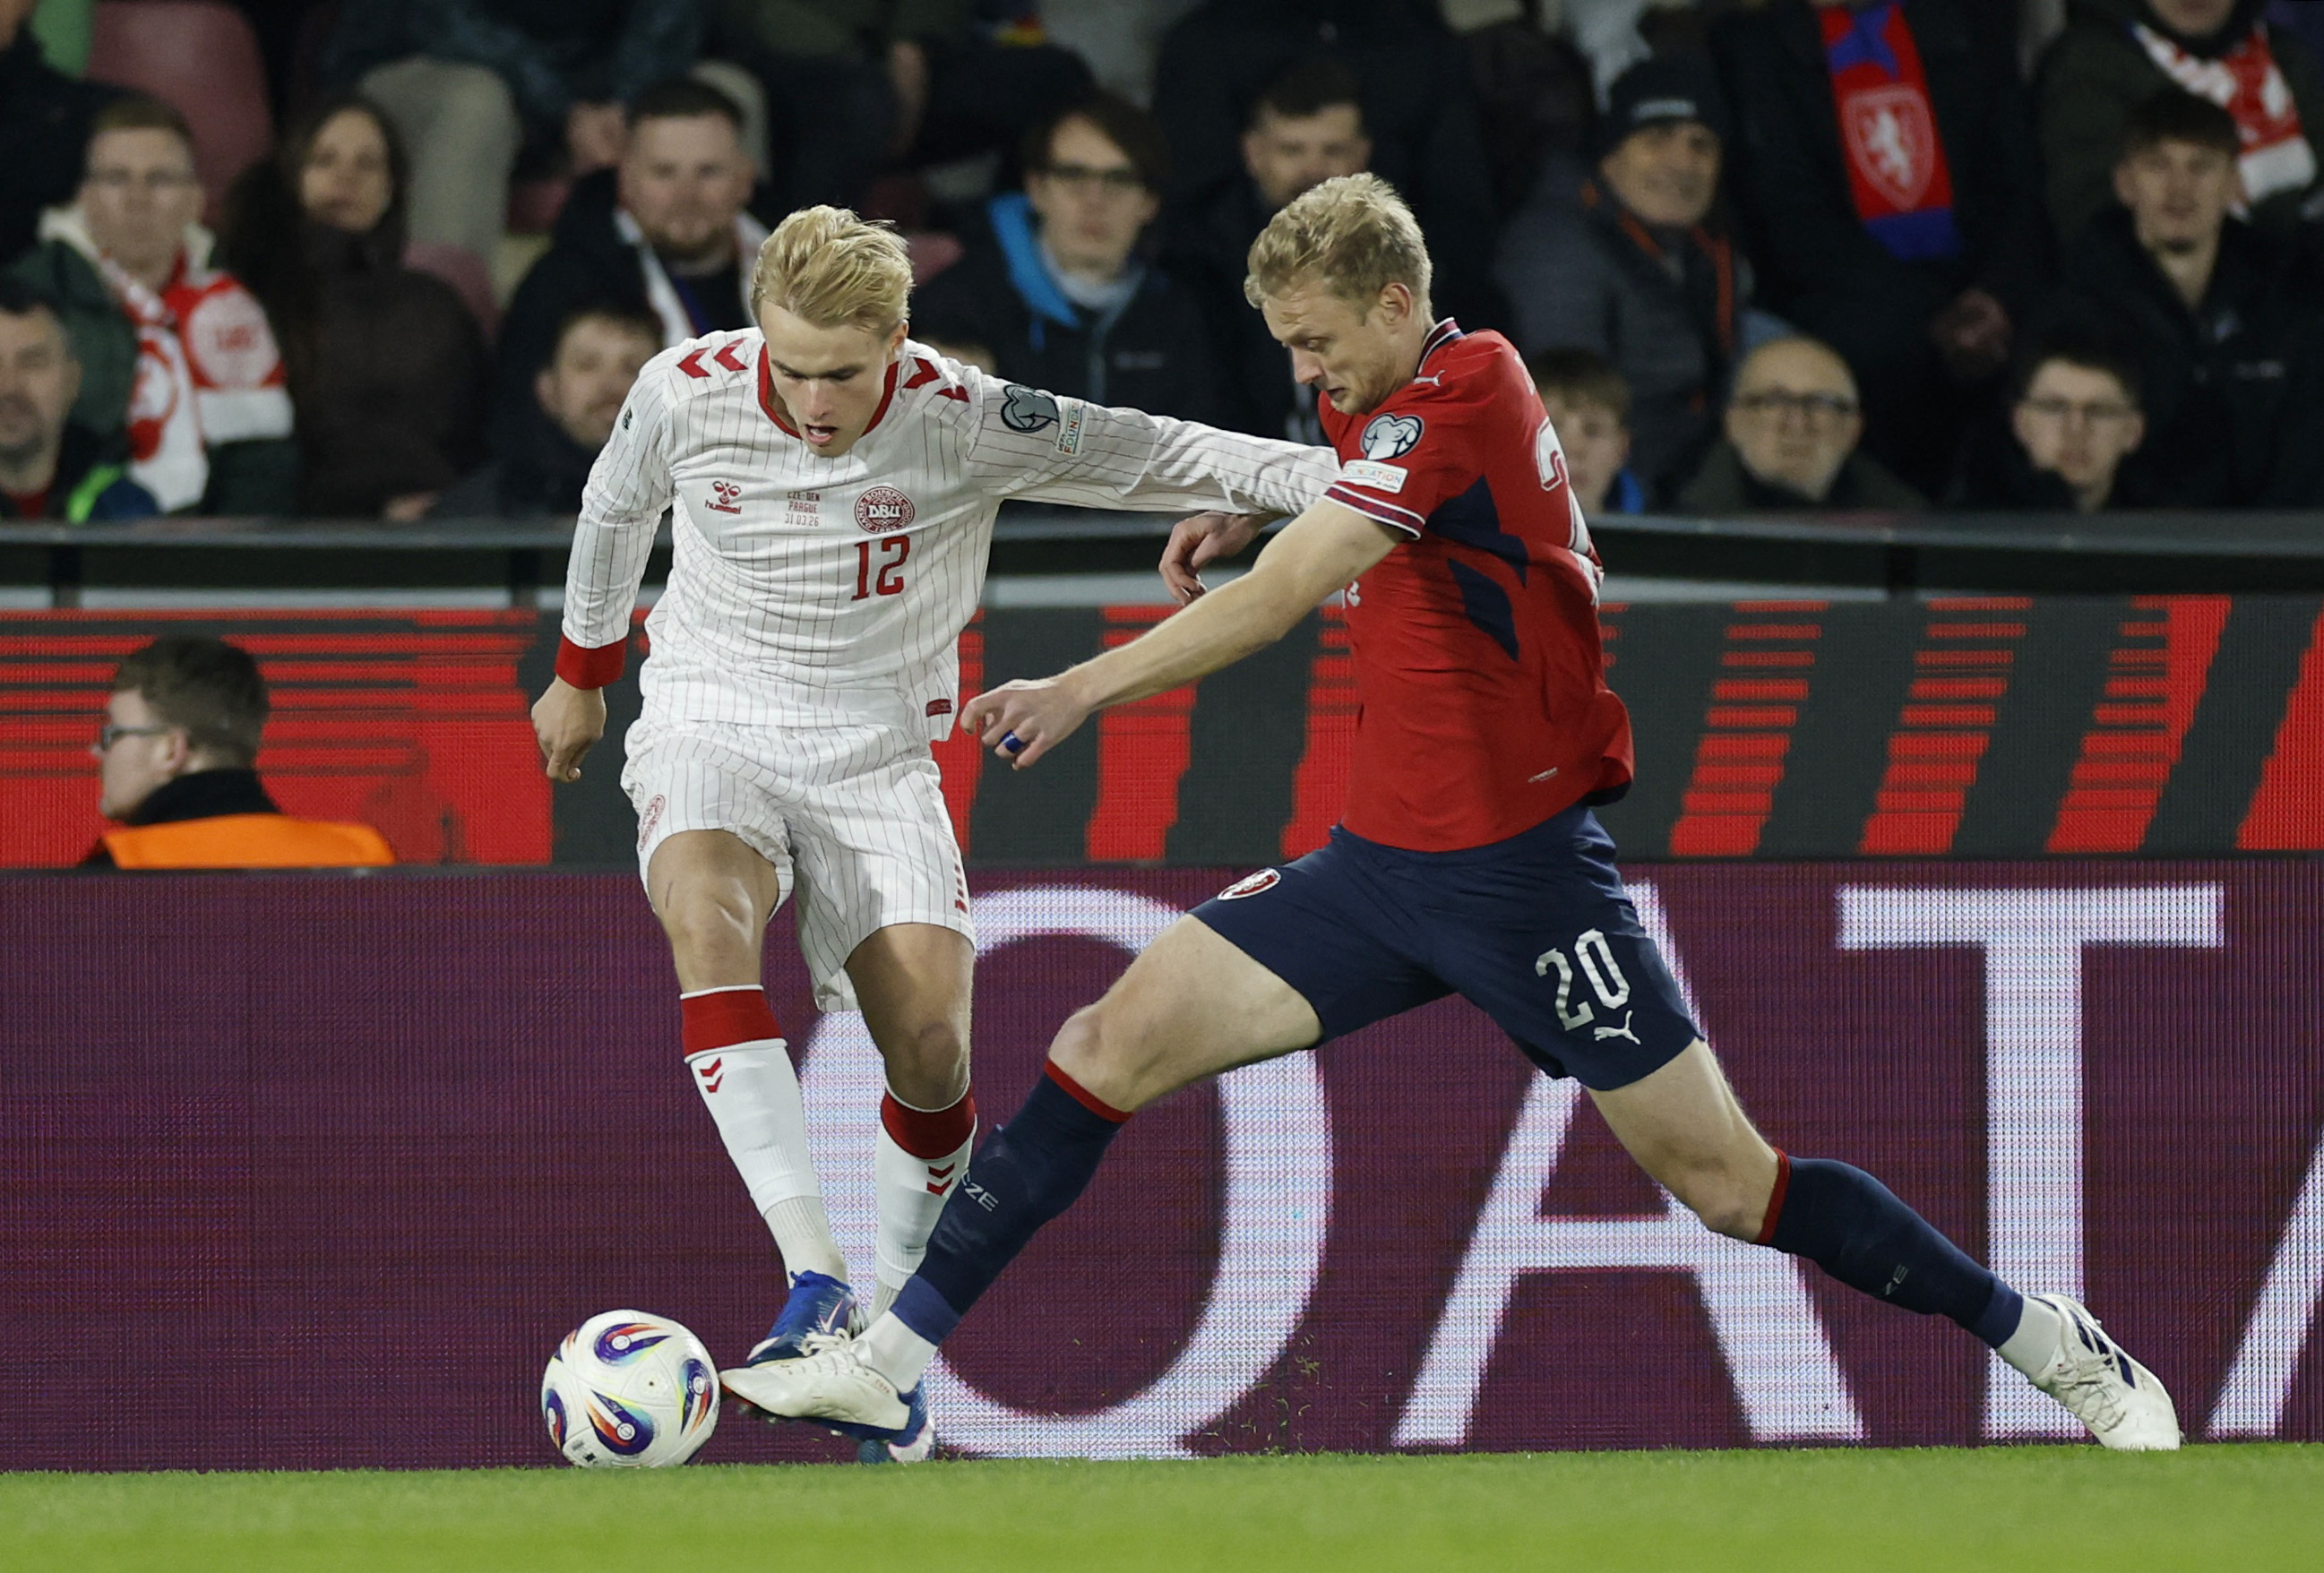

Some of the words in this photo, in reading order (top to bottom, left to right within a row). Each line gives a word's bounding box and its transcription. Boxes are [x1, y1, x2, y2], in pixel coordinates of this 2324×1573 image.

[704, 499, 742, 515] hummel
[788, 501, 818, 514] PRAGUE
[868, 504, 901, 518] DBU
[851, 535, 910, 601] 12
[1535, 927, 1631, 1031] 20
[797, 880, 2324, 1461] QAT
